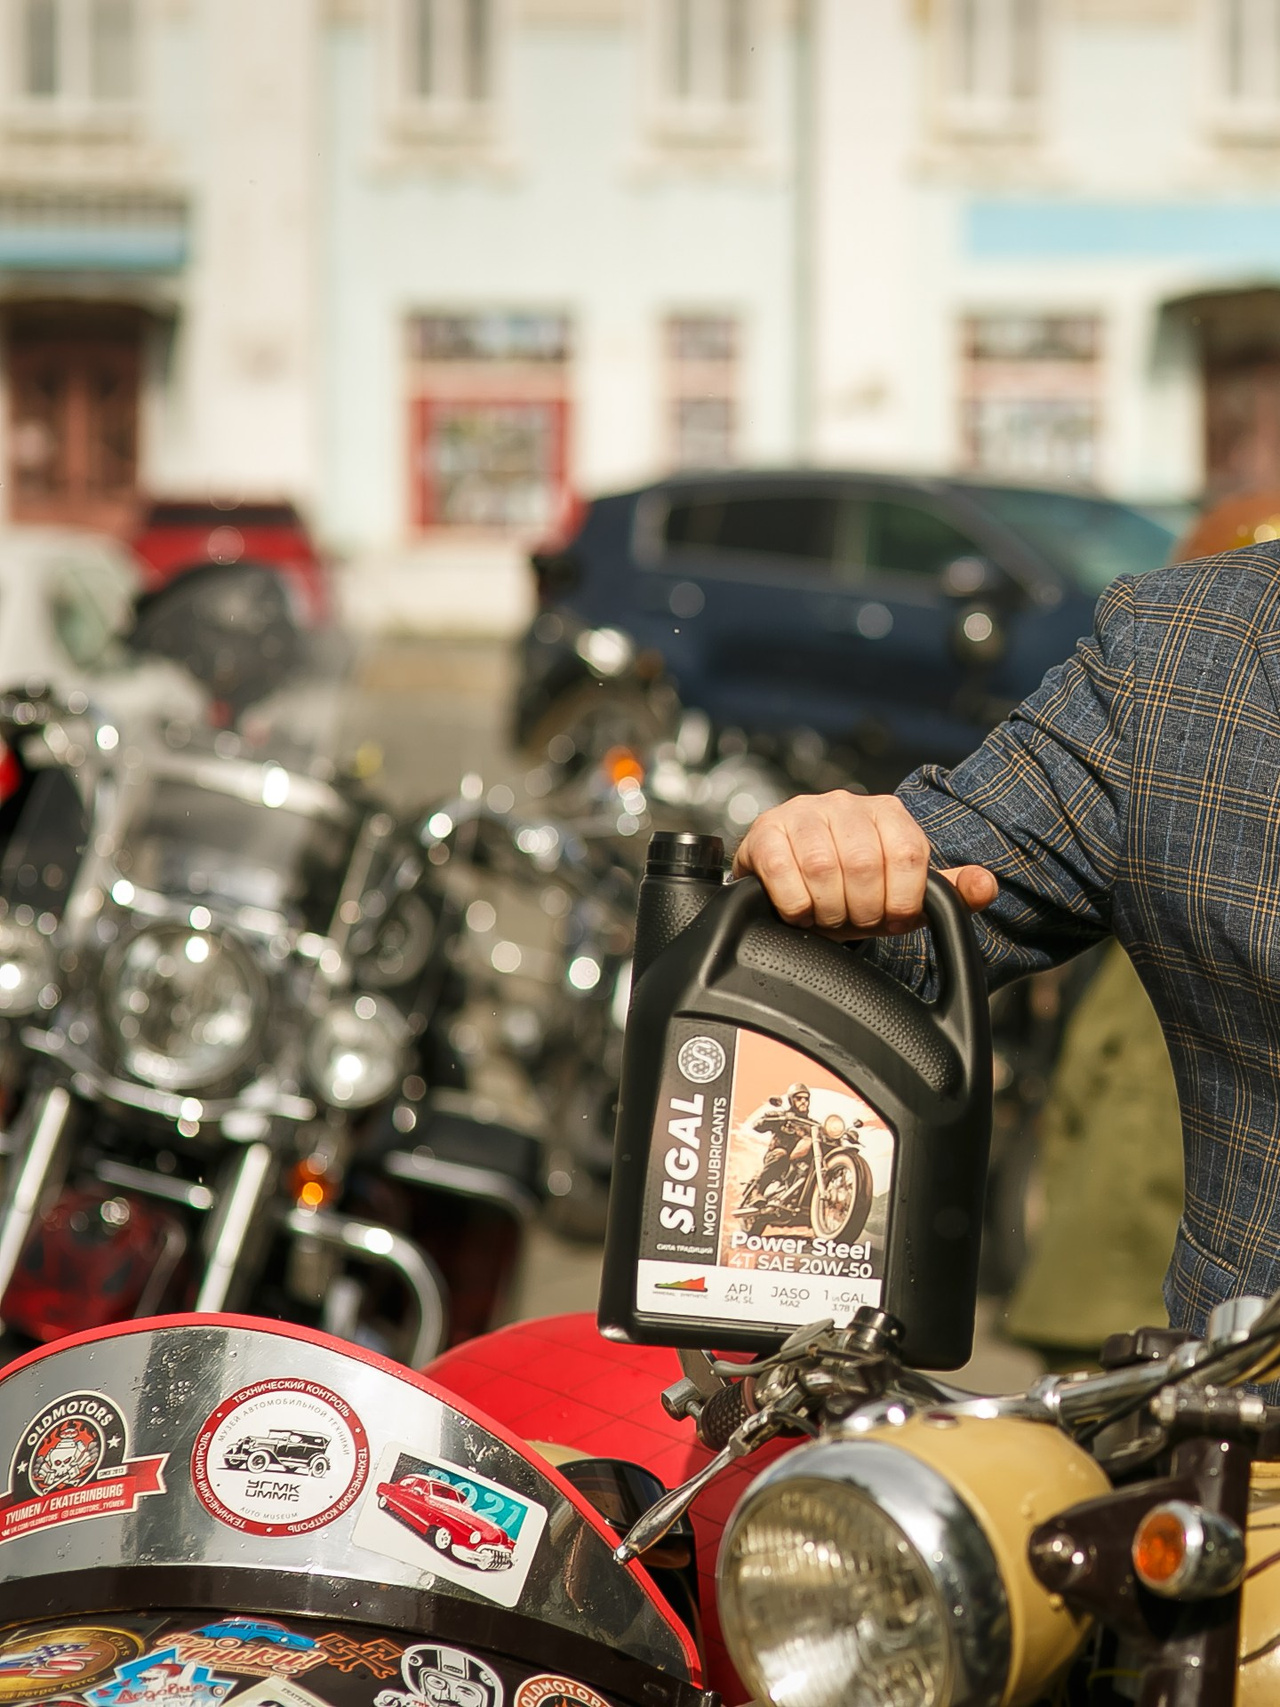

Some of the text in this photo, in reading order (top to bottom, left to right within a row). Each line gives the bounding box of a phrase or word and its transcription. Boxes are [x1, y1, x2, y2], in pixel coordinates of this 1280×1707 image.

[659, 1093, 705, 1235] SEGAL
[702, 1097, 727, 1236] MOTO LUBRICANTS
[731, 1231, 872, 1261] Power Steel
[728, 1252, 873, 1279] 4T SAE 20W-50
[726, 1283, 753, 1295] API
[770, 1286, 811, 1301] JASO
[779, 1299, 801, 1309] MA2
[231, 1380, 351, 1418] ТЕХНИЧЕСКИЙ КОНТРОЛЬ
[27, 1400, 114, 1447] OLDMOTORS
[194, 1431, 247, 1529] ТЕХНИЧЕСКИЙ КОНТРОЛЬ
[287, 1447, 368, 1534] ТЕХНИЧЕСКИЙ КОНТРОЛЬ
[5, 1504, 42, 1526] TYUMEN
[50, 1483, 124, 1511] EKATERINBURG
[263, 1511, 299, 1521] MUSEUM
[520, 1680, 607, 1707] OLDMOTOR
